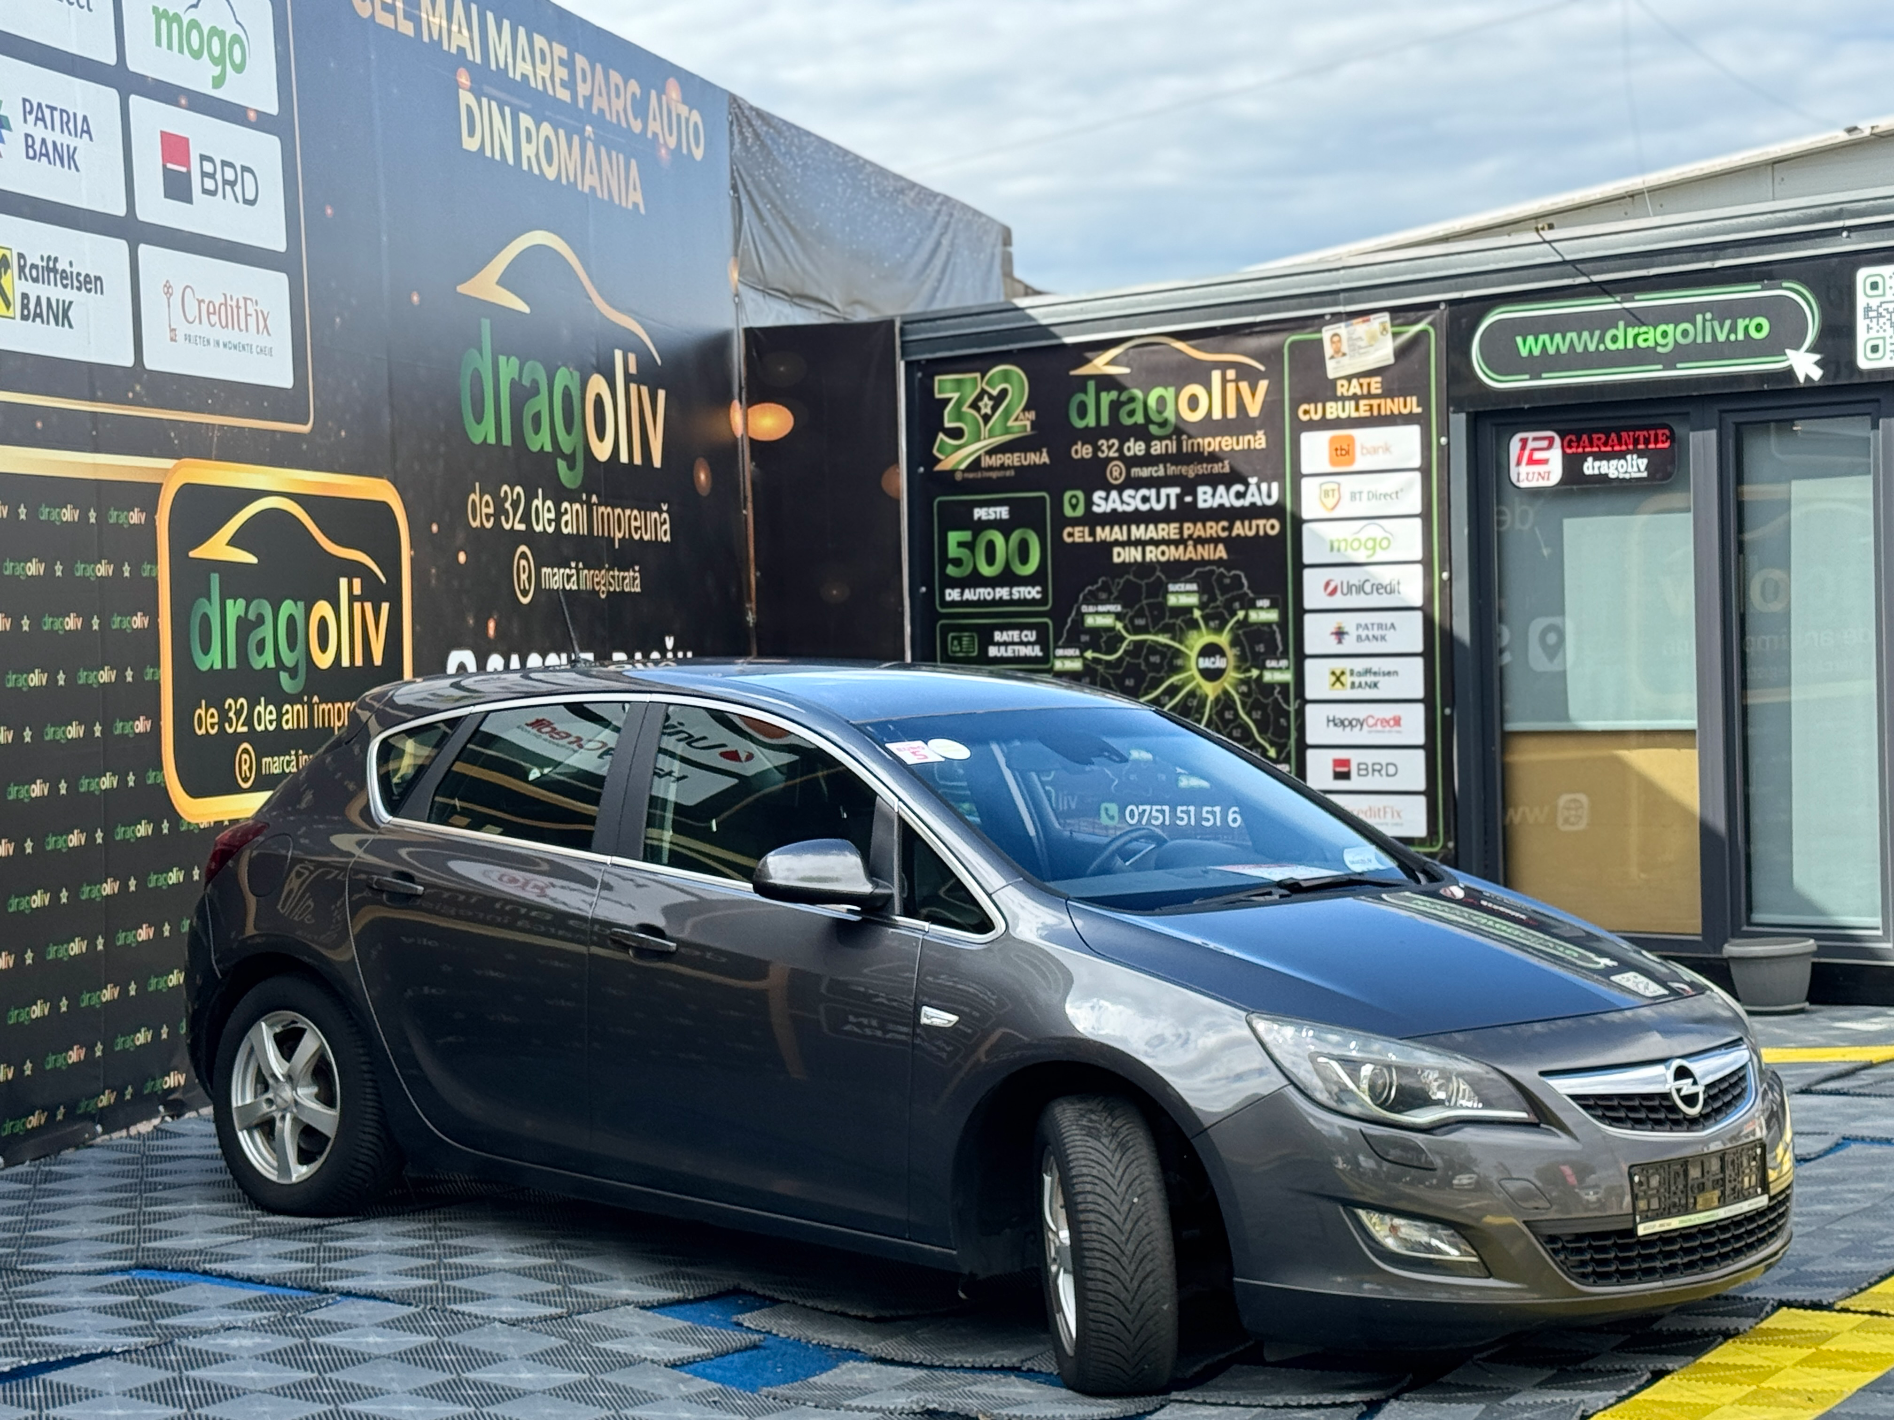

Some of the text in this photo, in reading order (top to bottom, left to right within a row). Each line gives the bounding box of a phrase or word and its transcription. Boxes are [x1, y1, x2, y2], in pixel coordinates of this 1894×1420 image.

[152, 5, 248, 89] mogo
[422, 0, 482, 65] MAI
[486, 10, 571, 104] MARE
[575, 52, 642, 134] PARC
[646, 89, 705, 162] AUTO
[21, 97, 94, 142] PATRIA
[24, 133, 80, 173] BANK
[458, 88, 646, 216] DIN ROMÂNIA
[199, 153, 259, 207] BRD
[17, 252, 104, 296] Raiffeisen
[20, 293, 74, 329] BANK
[181, 284, 271, 336] CreditFix
[1515, 312, 1770, 358] www.dragoliv.ro
[1336, 377, 1382, 397] RATE
[460, 318, 666, 489] dragoliv
[933, 364, 1030, 460] 32
[1068, 368, 1269, 436] dragoliv
[1298, 396, 1422, 421] CU BULETINUL
[1018, 410, 1036, 421] ANI
[1071, 430, 1266, 459] de 32 de ani împreună
[1334, 442, 1393, 457] tbi bank
[1515, 436, 1555, 467] 12
[1563, 429, 1671, 454] GARANTIE
[981, 447, 1050, 468] ÎMPREUNĂ
[1130, 463, 1165, 478] marcă
[1166, 460, 1230, 478] înregistrată
[1583, 454, 1648, 478] dragoliv
[1516, 471, 1552, 483] LUNI
[1091, 487, 1181, 514] SASCUT
[1196, 477, 1279, 510] BACĂU
[1323, 488, 1337, 499] BT
[1350, 491, 1364, 502] BT
[38, 504, 146, 528] dragoliv dragoliv
[467, 482, 671, 549] de 32 de ani împreună
[973, 506, 1010, 521] PESTE
[1062, 518, 1281, 543] CEL MAI MARE PARC AUTO
[945, 528, 1041, 578] 500
[1112, 540, 1228, 563] DIN ROMÂNIA
[1329, 536, 1392, 559] mogo
[2, 558, 113, 581] dragoliv dragoliv
[541, 561, 578, 591] marcă
[578, 562, 641, 599] înregistrată
[945, 586, 1042, 601] DE AUTO PE STOC
[1340, 579, 1401, 597] UniCredit
[42, 612, 149, 634] dragoliv dragoliv
[189, 572, 390, 694] dragoliv
[1356, 622, 1397, 632] PATRIA
[994, 630, 1037, 642] RATE CU
[1356, 634, 1388, 643] BANK
[988, 645, 1043, 657] BULETINUL
[1198, 654, 1227, 670] BACĂU
[5, 666, 117, 691] dragoliv dragoliv
[1349, 667, 1399, 678] Raiffeisen
[1350, 681, 1380, 690] BANK
[194, 694, 356, 736] de 32 de ani împr
[1326, 714, 1402, 732] HappyCredit
[43, 716, 151, 742] dragoliv dragoliv
[262, 750, 297, 775] marcă
[1357, 762, 1398, 777] BRD
[6, 779, 49, 802] dragoliv
[78, 772, 118, 795] dragoliv
[1125, 805, 1242, 828] 0751 51 51 6
[45, 829, 86, 851] dragoliv
[114, 820, 154, 842] dragoliv
[7, 867, 185, 913] dragoliv dragoliv dragoliv
[46, 937, 88, 961] dragoliv
[115, 923, 155, 947] dragoliv
[7, 969, 185, 1025] dragoliv dragoliv dragoliv
[44, 1027, 153, 1070] dragoliv dragoliv
[1, 1070, 186, 1136] dragoliv dragoliv dragoliv
